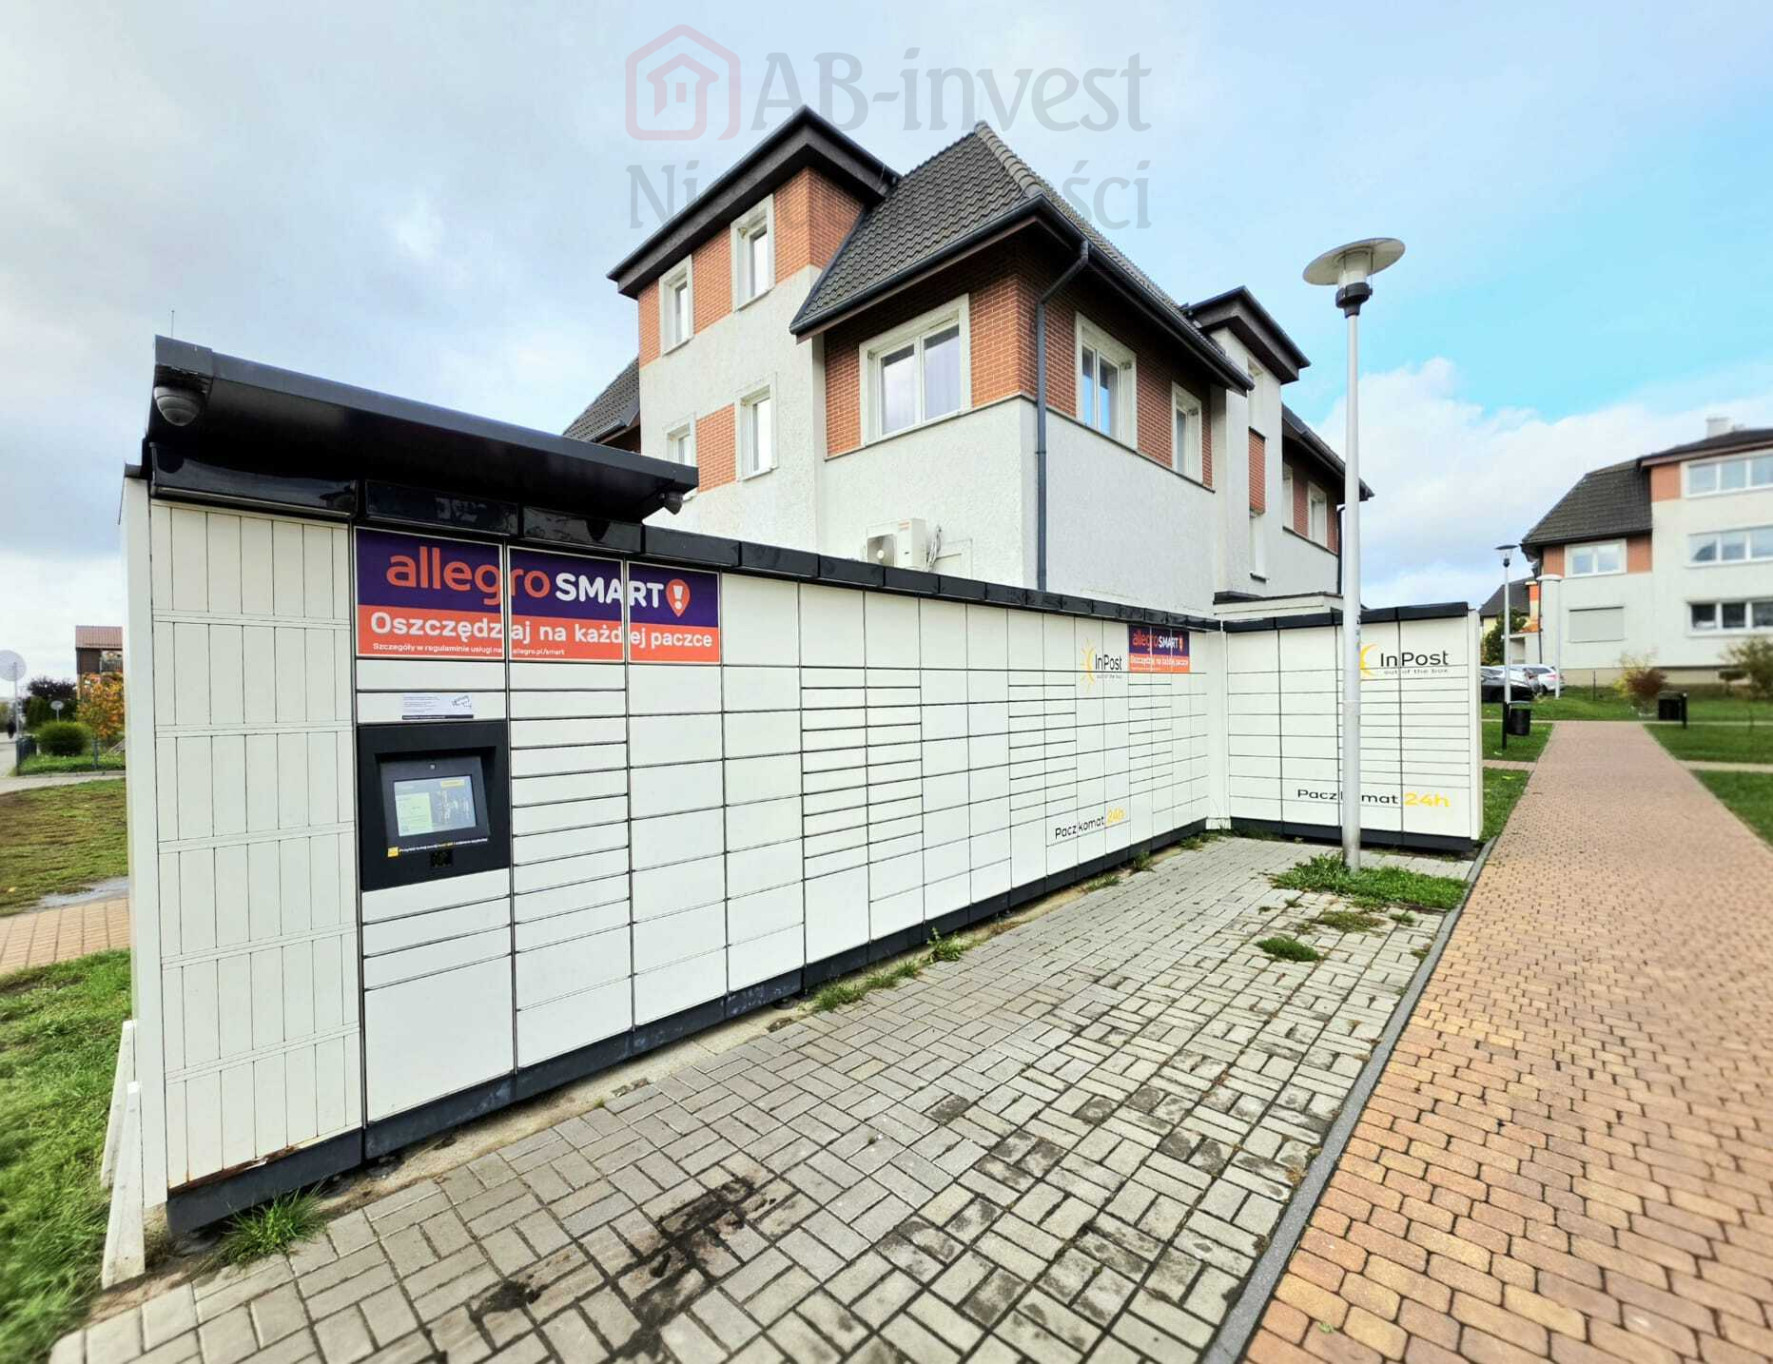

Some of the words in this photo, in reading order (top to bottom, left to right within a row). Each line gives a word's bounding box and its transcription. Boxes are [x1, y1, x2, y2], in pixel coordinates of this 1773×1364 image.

[386, 546, 550, 606] allegro
[371, 611, 531, 644] Oszczędzaj
[539, 625, 566, 641] na
[575, 623, 646, 648] każdej
[651, 630, 713, 648] paczce
[1095, 654, 1122, 671] InPost
[1380, 650, 1449, 668] InPost
[1297, 789, 1399, 805] Paczmat
[1404, 791, 1450, 808] 24h
